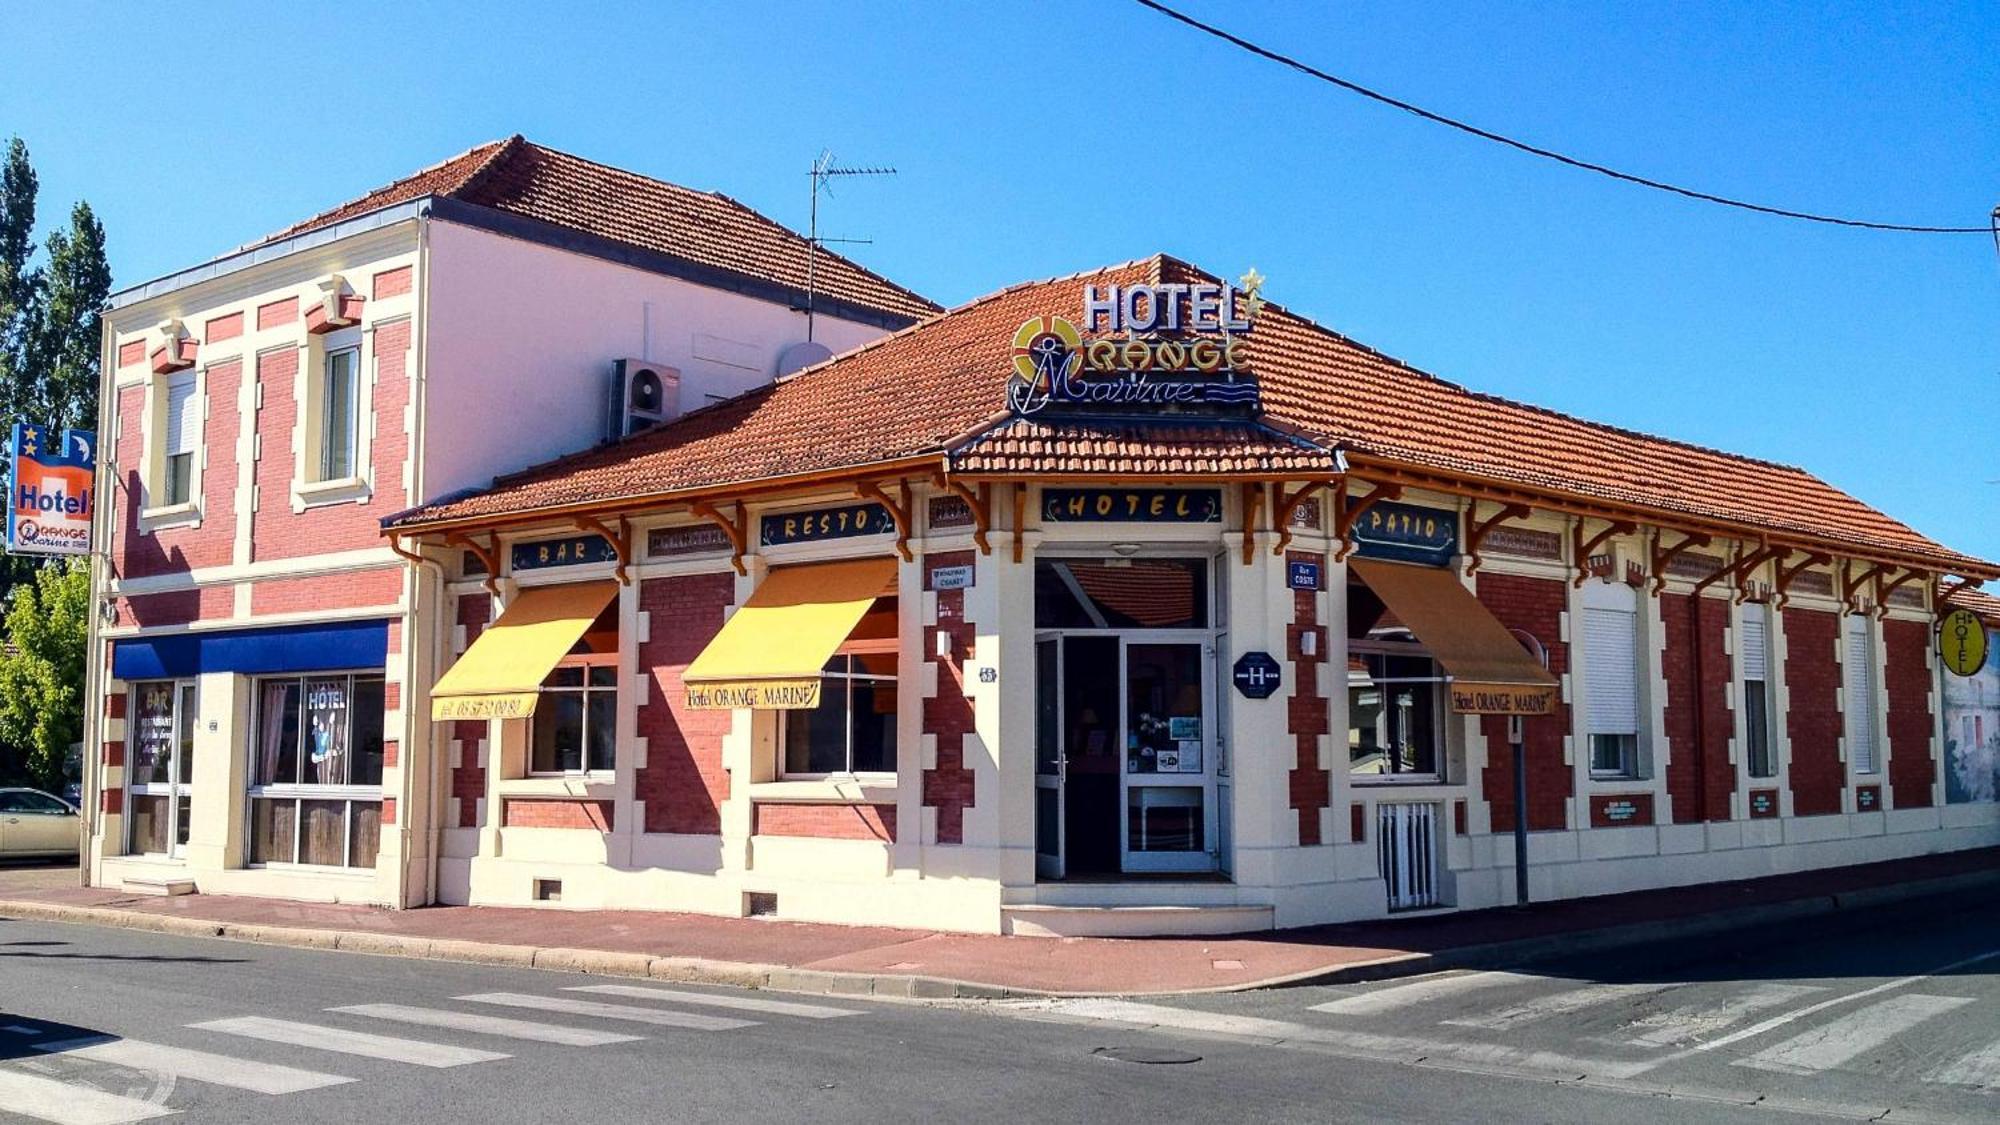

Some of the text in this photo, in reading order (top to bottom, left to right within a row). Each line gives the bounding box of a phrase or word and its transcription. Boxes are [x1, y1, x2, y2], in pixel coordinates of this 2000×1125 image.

[1083, 282, 1251, 331] HOTEL
[1044, 350, 1196, 401] Marine
[20, 484, 88, 514] Hotel
[1068, 494, 1190, 517] HOTEL
[784, 509, 868, 538] RESTO
[1371, 511, 1435, 538] PATIO
[539, 542, 586, 562] BAR
[1955, 612, 1968, 674] HOTEL
[1249, 667, 1265, 685] H
[146, 690, 168, 711] BAR
[714, 687, 758, 706] ORANGE
[764, 685, 810, 706] MARINE
